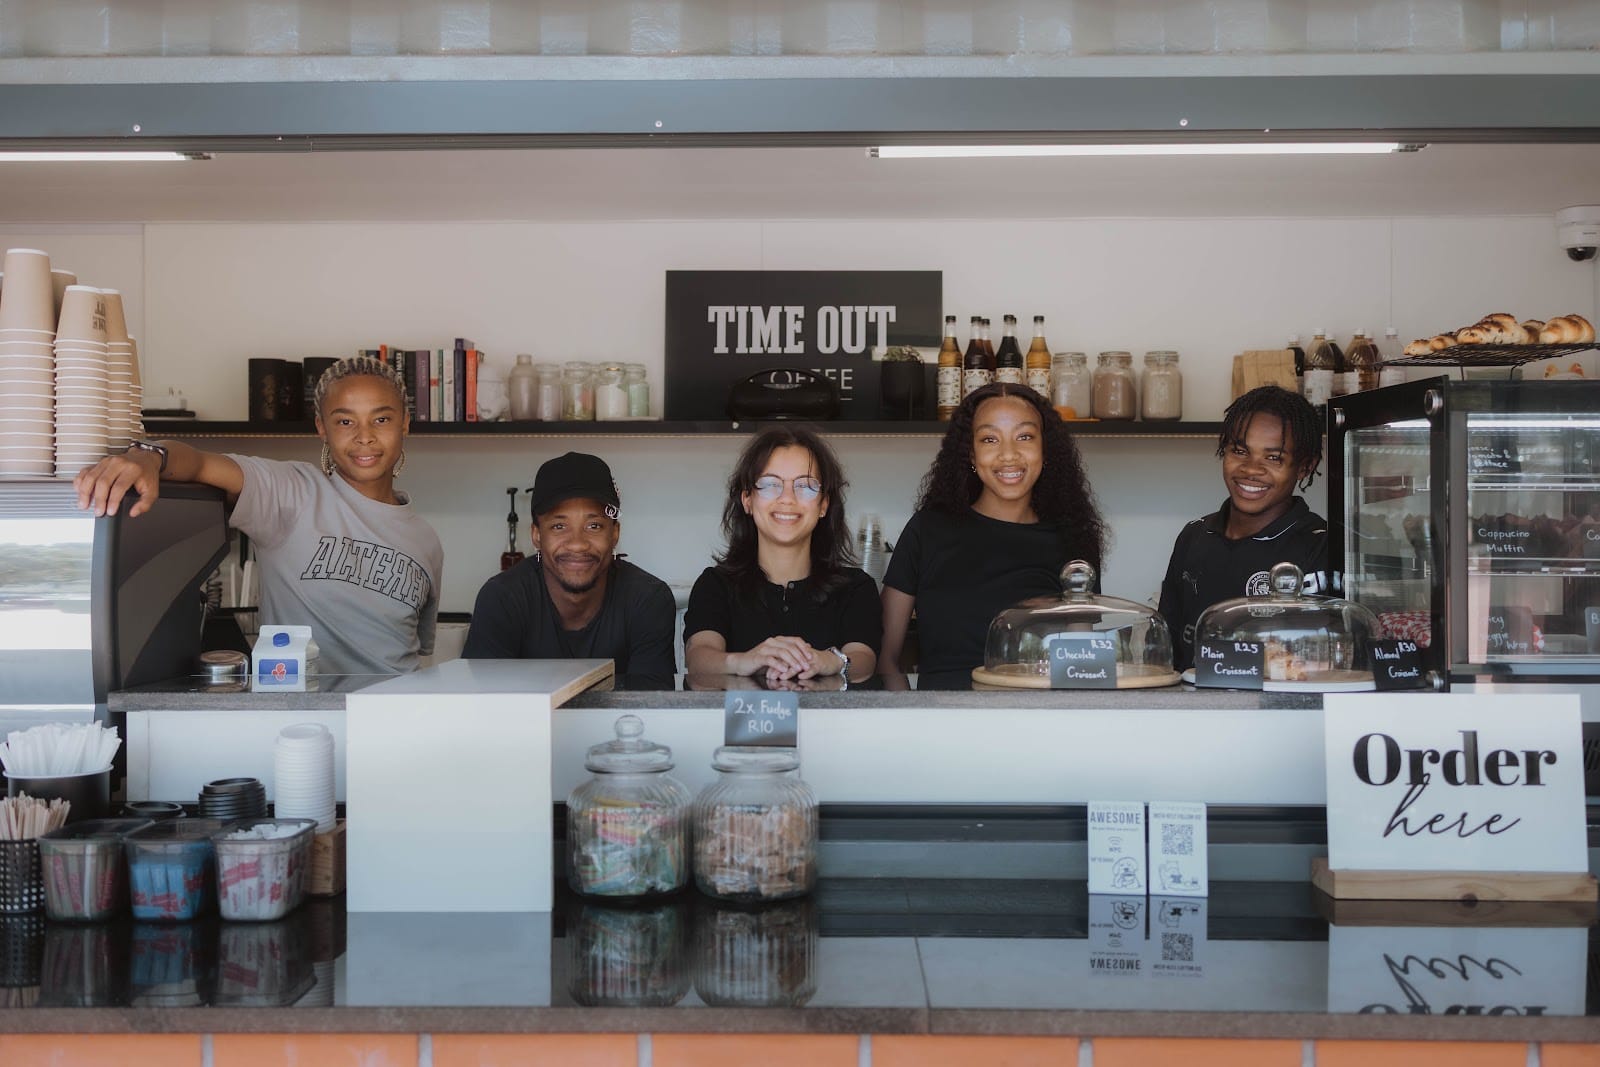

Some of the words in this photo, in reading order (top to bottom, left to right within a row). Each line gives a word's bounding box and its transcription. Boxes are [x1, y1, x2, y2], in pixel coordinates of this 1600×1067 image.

[707, 305, 804, 354] TIME
[817, 305, 896, 354] OUT
[1478, 528, 1530, 540] Cappucino
[1486, 543, 1525, 553] Muffin
[1090, 639, 1114, 650] R32
[1234, 642, 1258, 654] R25
[1397, 642, 1417, 653] R30
[1056, 647, 1096, 660] Chocolate
[1201, 645, 1224, 659] Plain
[1214, 662, 1259, 676] Croissant
[734, 698, 756, 715] 2x
[760, 700, 792, 720] Fudge
[748, 719, 774, 734] R10
[1353, 730, 1557, 786] Order
[1383, 772, 1521, 838] here
[1089, 811, 1141, 825] AWESOME
